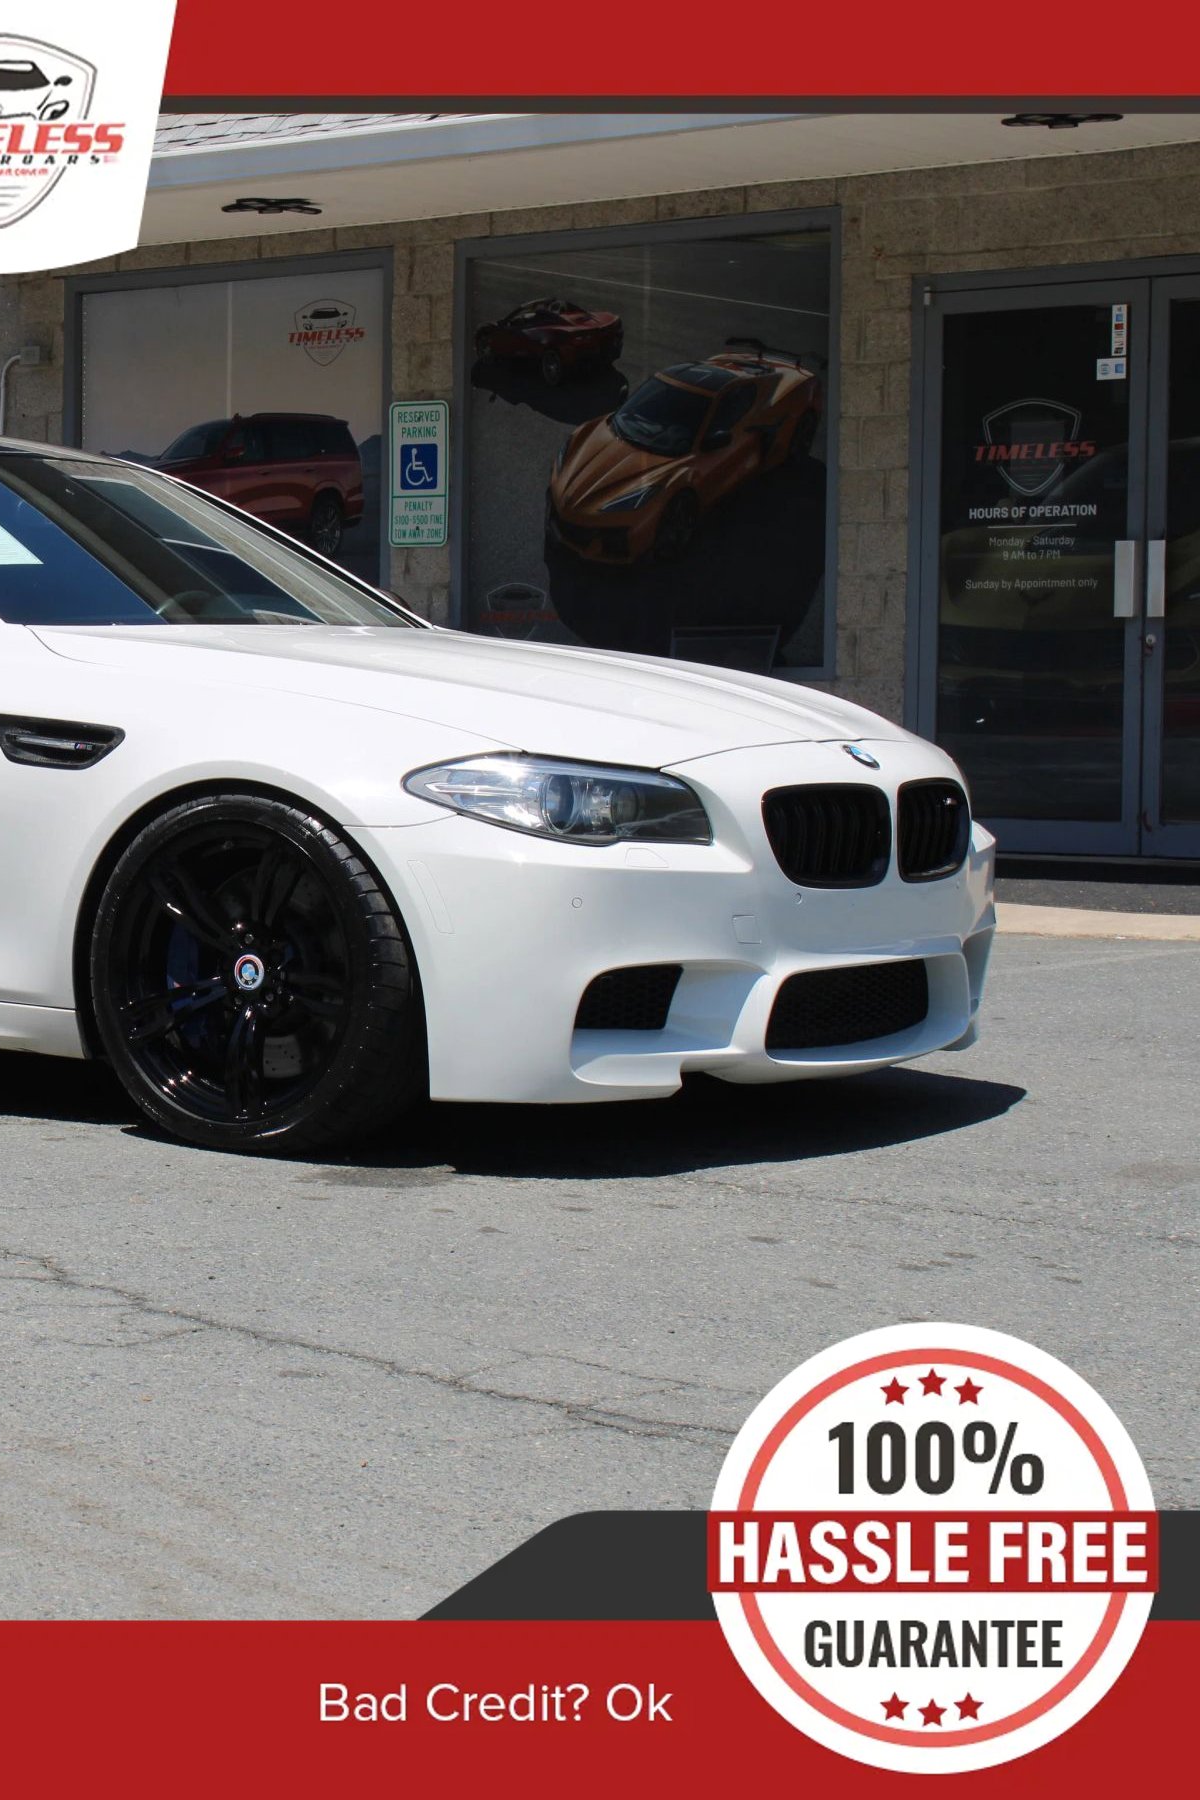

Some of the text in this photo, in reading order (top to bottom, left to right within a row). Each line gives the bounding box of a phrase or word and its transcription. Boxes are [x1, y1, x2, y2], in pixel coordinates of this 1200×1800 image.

[288, 327, 366, 343] TIMELESS
[397, 411, 440, 423] RESERVED
[401, 426, 437, 438] PARKING
[973, 440, 1097, 462] TIMELESS
[404, 501, 433, 512] PENALTY
[969, 504, 1097, 520] HOURS OF OPERATION
[429, 514, 443, 525] FINE
[394, 527, 442, 539] TOW AWAY ZONE
[988, 536, 1025, 548] Monday
[1032, 535, 1076, 547] Saturday
[1010, 550, 1025, 560] AM
[1027, 551, 1037, 560] to
[1046, 549, 1061, 559] PM
[965, 577, 1098, 591] Sunday by Appointment only
